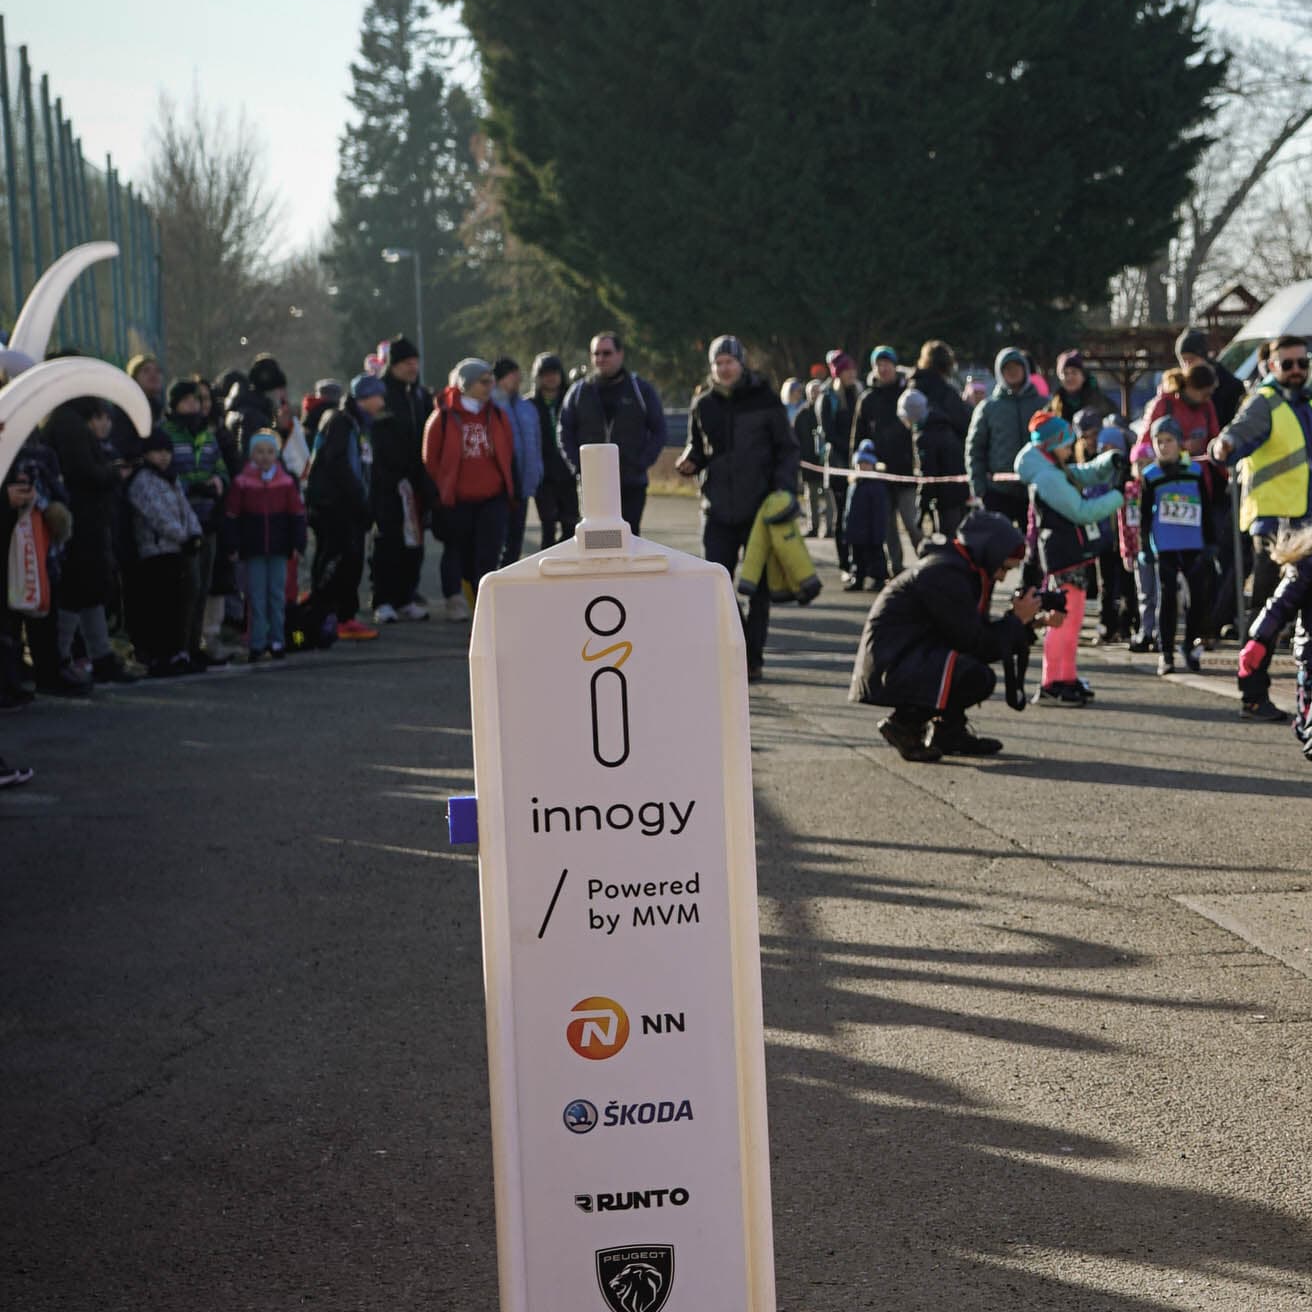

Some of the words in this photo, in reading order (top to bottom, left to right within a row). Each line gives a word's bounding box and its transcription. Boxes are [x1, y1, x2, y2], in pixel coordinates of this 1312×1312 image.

[531, 797, 696, 836] innogy
[587, 872, 701, 900] Powered
[589, 907, 620, 935] by
[632, 903, 701, 928] MVM
[641, 1012, 686, 1035] NN
[603, 1099, 694, 1128] ŠKODA
[596, 1187, 689, 1212] RUNTO
[602, 1251, 667, 1264] PEUGEOT
